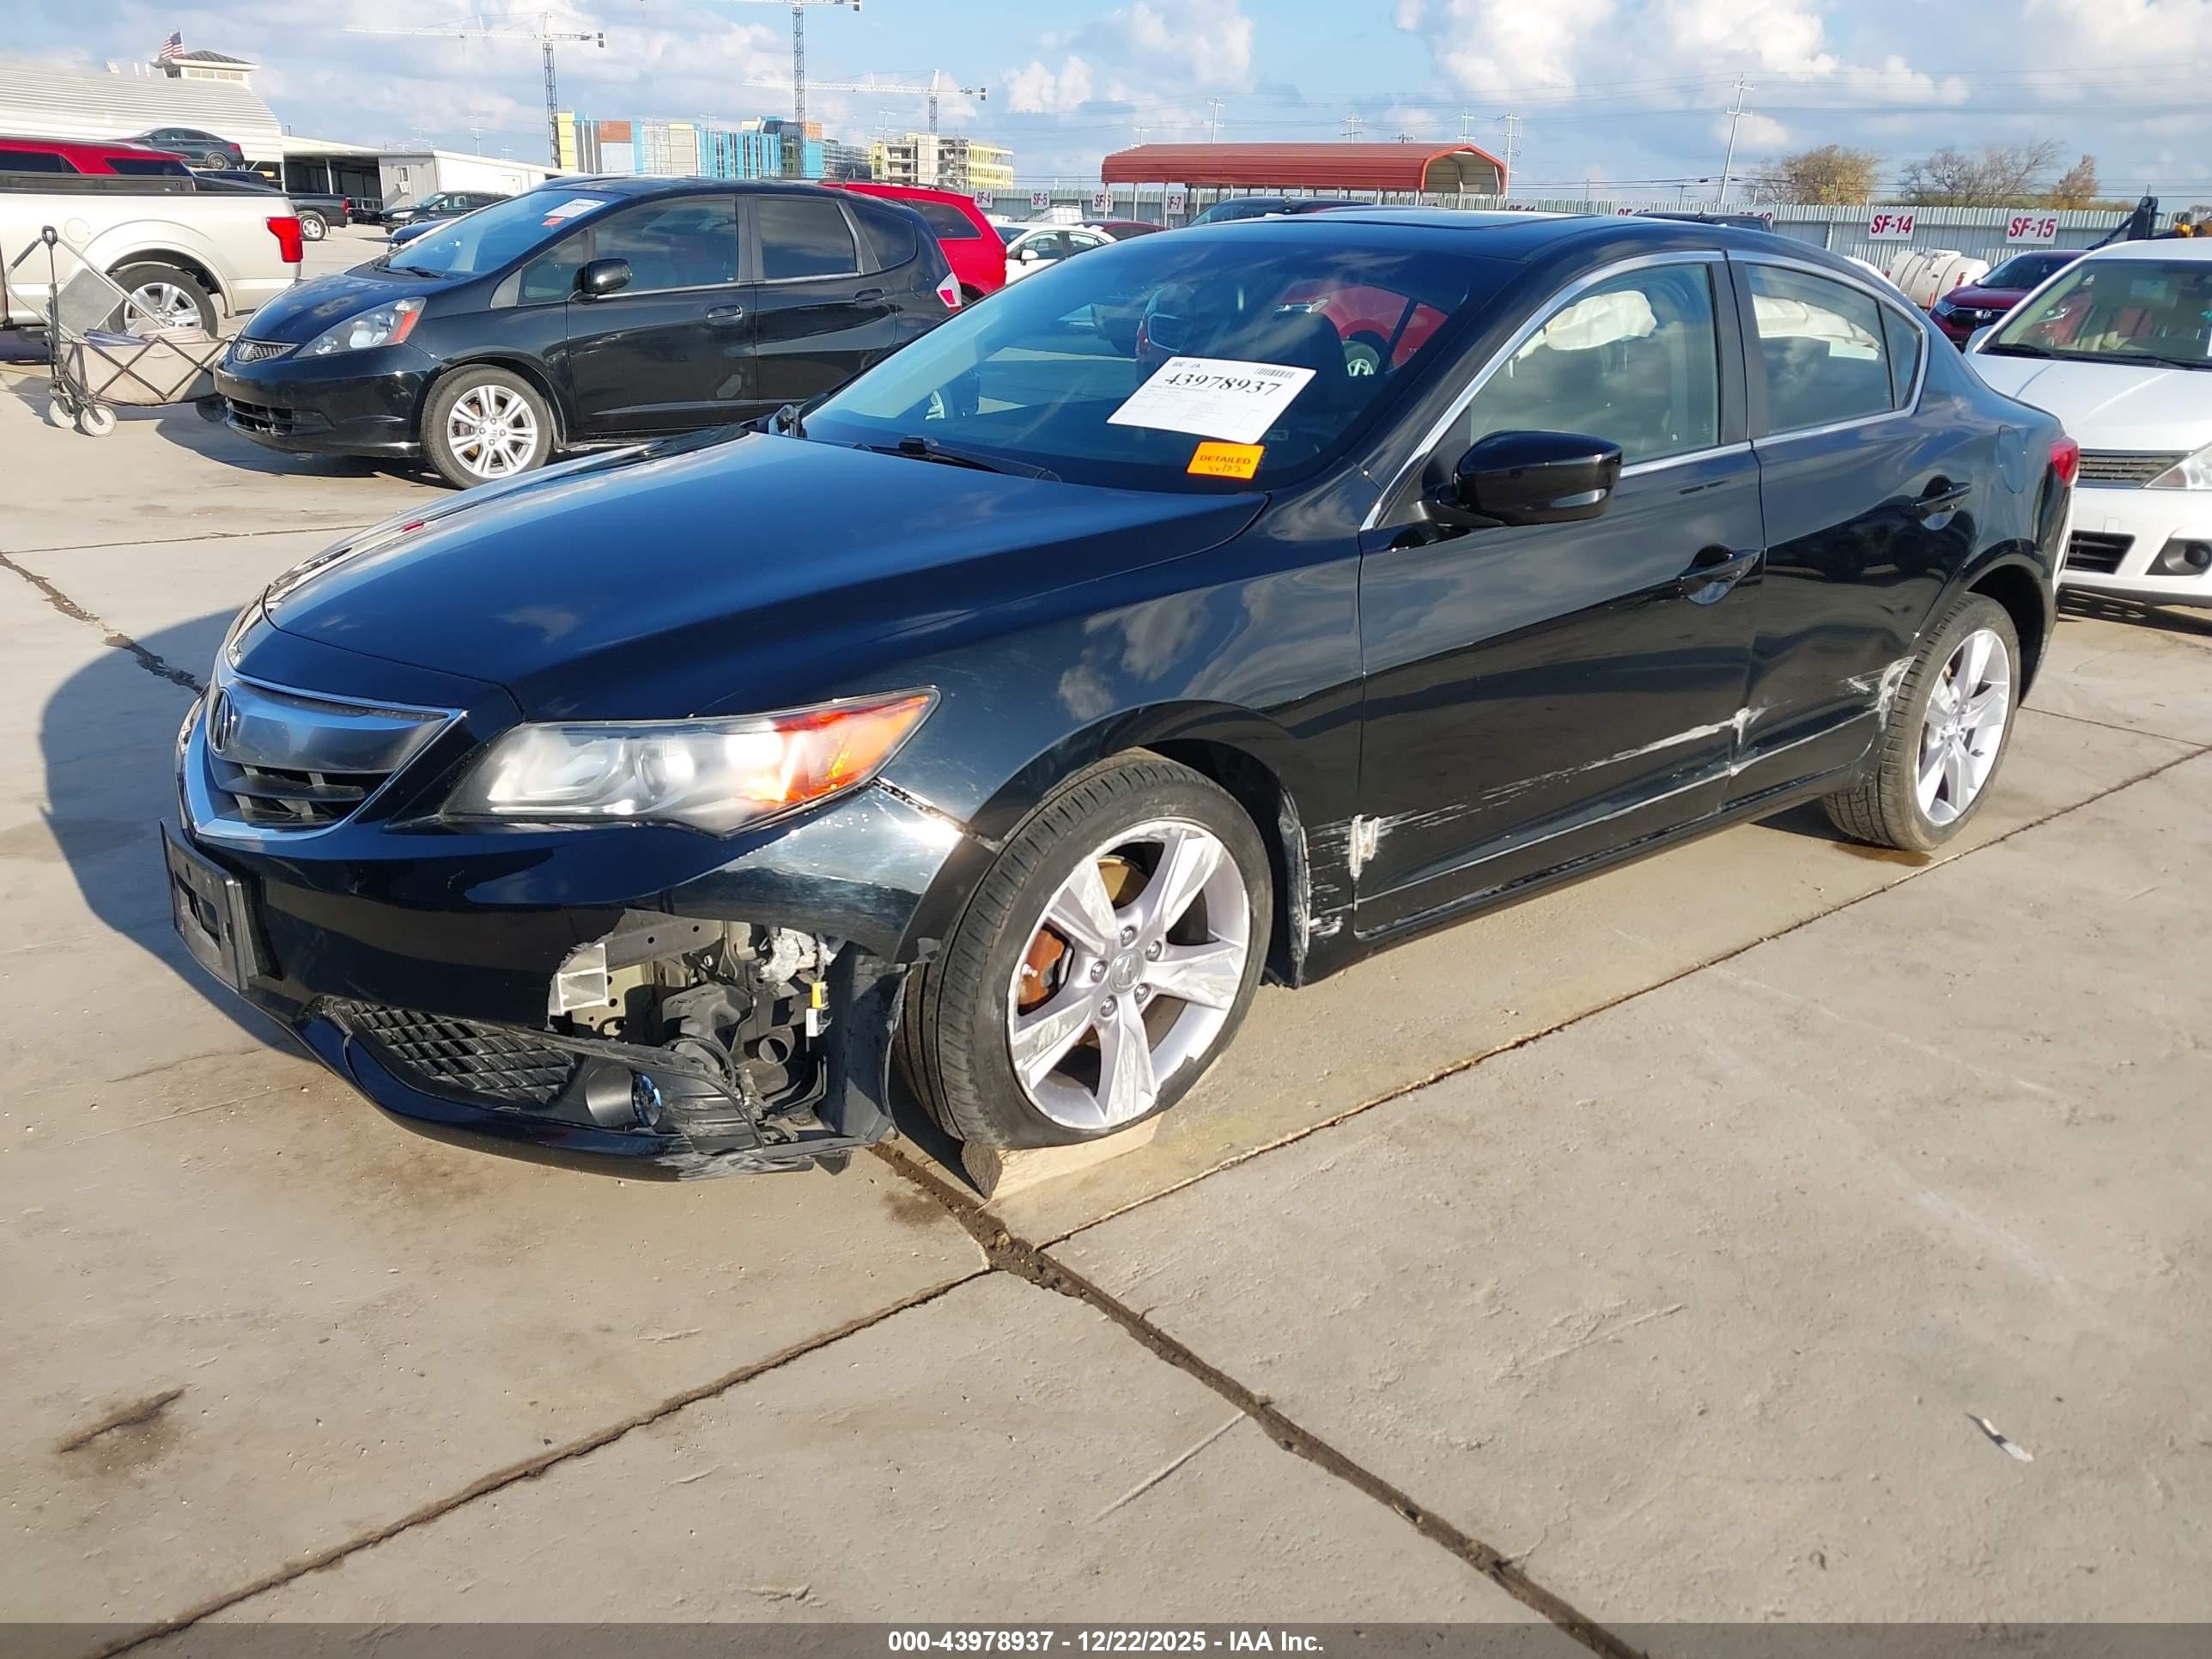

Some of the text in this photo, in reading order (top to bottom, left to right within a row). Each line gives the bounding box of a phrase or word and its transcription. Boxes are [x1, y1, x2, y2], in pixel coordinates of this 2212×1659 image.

[976, 191, 991, 204] SF-4
[1032, 192, 1048, 205] SF-5
[1870, 214, 1914, 234] SF-14
[2008, 216, 2057, 238] SF-15
[1164, 373, 1283, 396] 43978937
[1200, 454, 1251, 465] DETAILED
